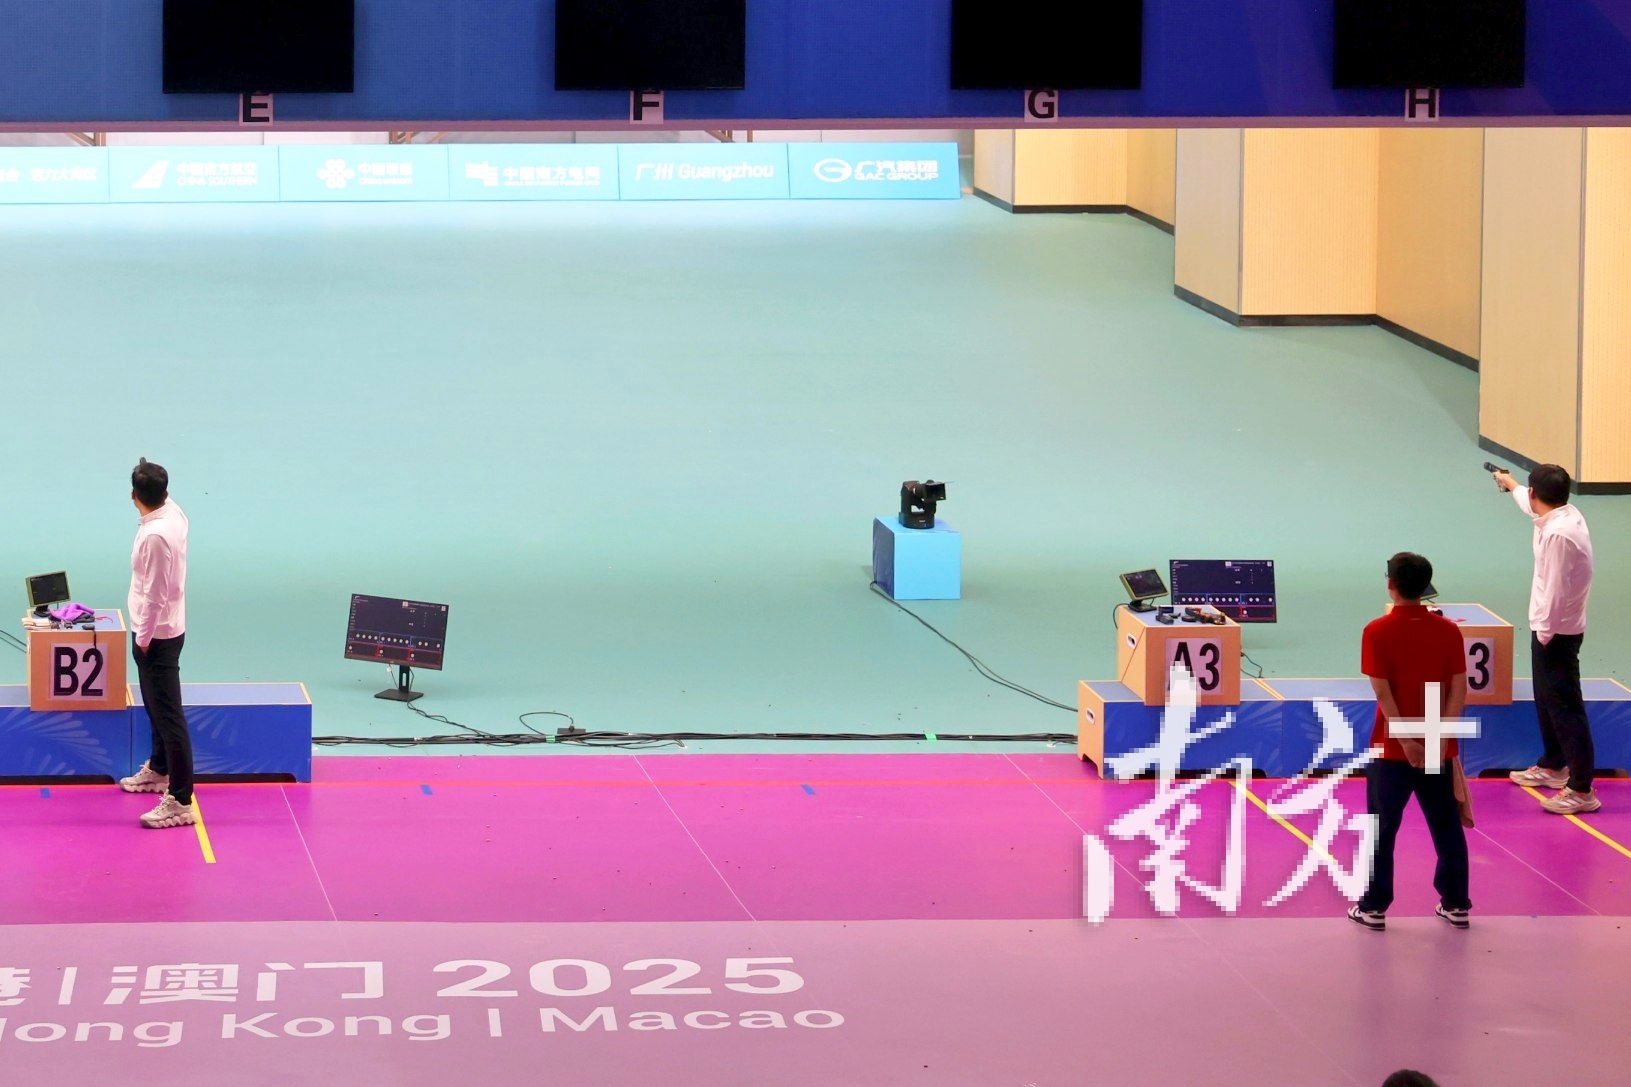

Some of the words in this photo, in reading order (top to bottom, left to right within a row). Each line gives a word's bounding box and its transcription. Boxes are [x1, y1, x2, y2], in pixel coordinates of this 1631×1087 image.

[244, 92, 270, 122] E
[633, 91, 659, 120] F
[1028, 88, 1056, 119] G
[1408, 88, 1435, 117] H
[635, 162, 674, 179] 广州
[678, 160, 774, 181] Guangzhou
[855, 171, 885, 179] GAC
[887, 171, 938, 179] GROUP
[54, 647, 103, 697] B2
[1169, 642, 1220, 692] A3
[1468, 642, 1489, 690] 3
[431, 957, 806, 997] 2025
[220, 1011, 452, 1040] Kong
[541, 1005, 846, 1033] Macao
